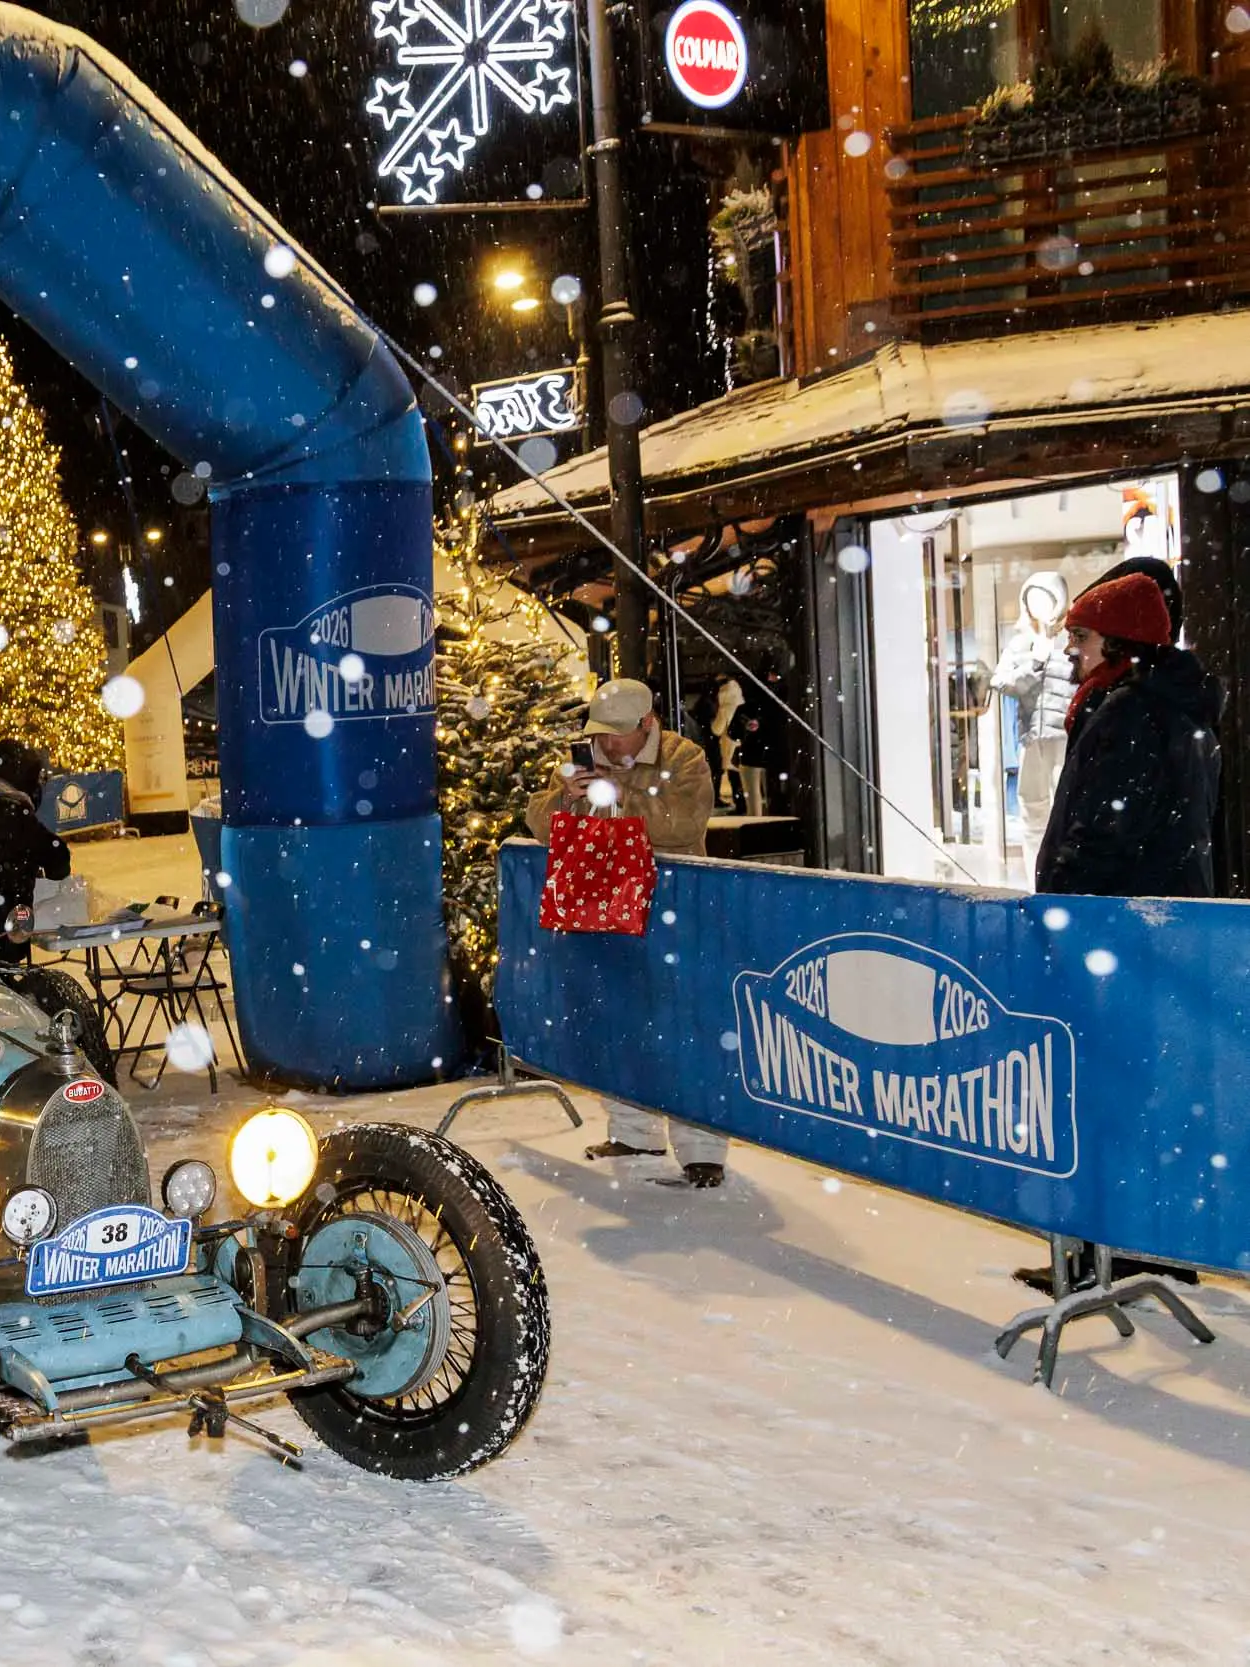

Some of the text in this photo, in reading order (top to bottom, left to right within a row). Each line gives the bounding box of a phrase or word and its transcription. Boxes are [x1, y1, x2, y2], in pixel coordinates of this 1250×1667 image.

[674, 35, 739, 71] COLMAR
[310, 606, 349, 649] 2026
[269, 637, 375, 715] WINTER
[186, 760, 219, 776] RENT
[784, 957, 827, 1018] 2026
[938, 974, 990, 1041] 2026
[68, 1085, 100, 1098] BUGATTI
[744, 983, 1055, 1162] WINTER MARATHON
[60, 1225, 87, 1251] 2026
[101, 1222, 129, 1245] 38
[140, 1215, 166, 1243] 2026
[43, 1225, 182, 1286] WINTER MARATHON
